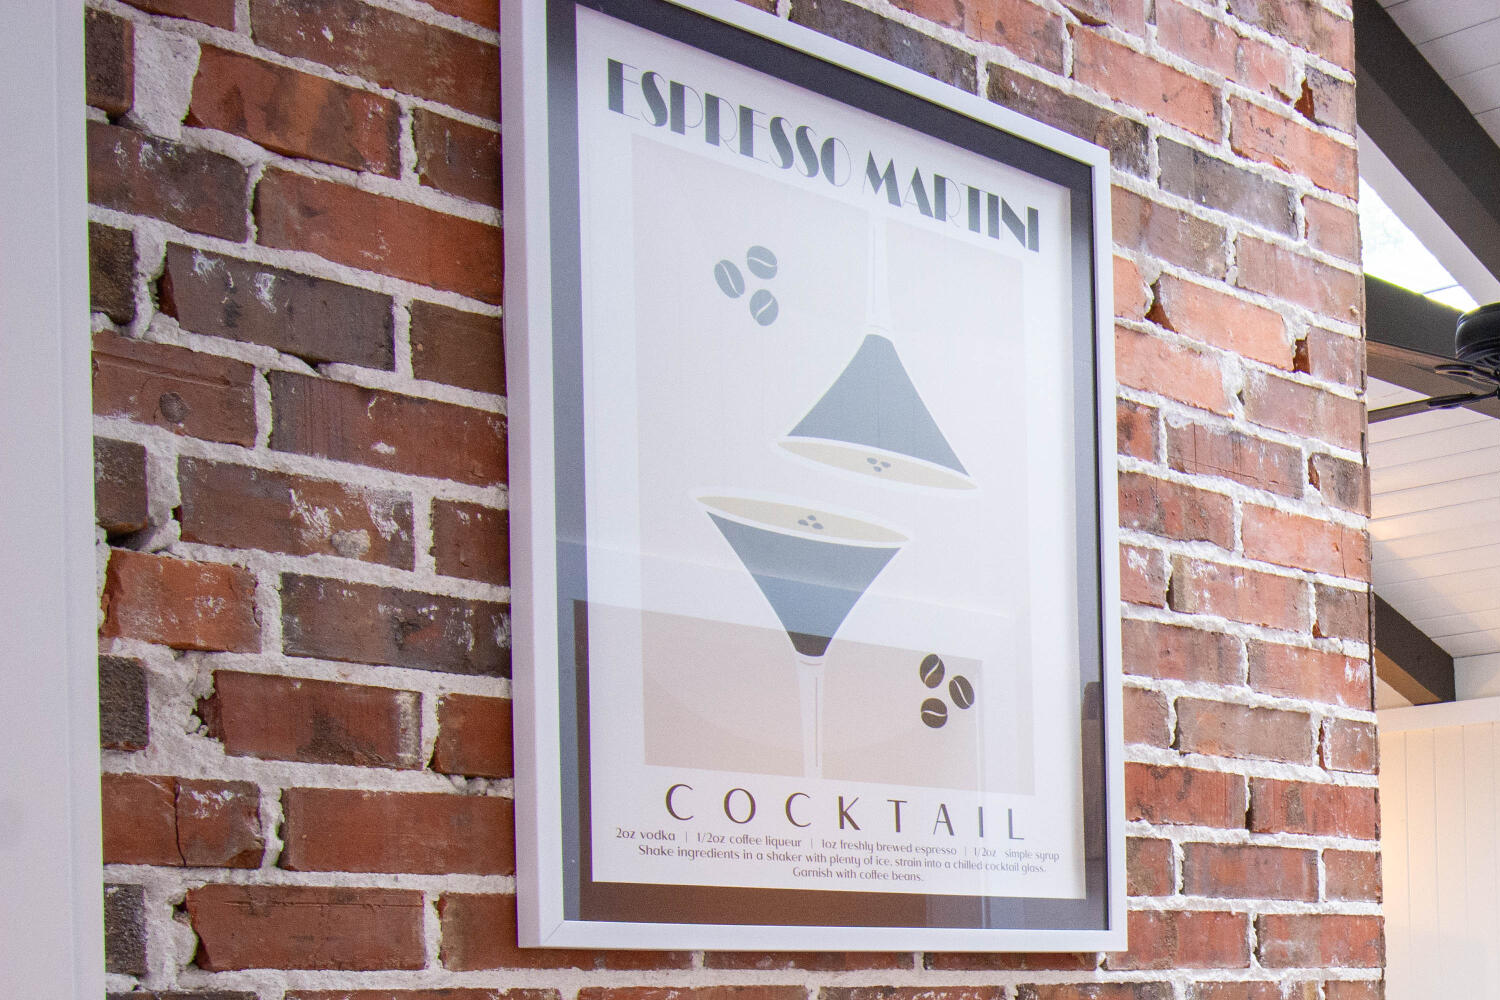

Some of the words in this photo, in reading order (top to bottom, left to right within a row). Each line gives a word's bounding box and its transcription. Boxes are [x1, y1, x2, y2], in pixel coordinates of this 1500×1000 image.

[607, 58, 851, 187] ESPRESSO
[863, 150, 1040, 253] MARTINI
[665, 783, 1026, 841] COCKTAIL
[616, 828, 635, 840] 2oz
[640, 830, 676, 842] vodka
[697, 832, 725, 844] 1/2oz
[730, 834, 762, 846] coffee
[765, 836, 802, 850] liqueur
[840, 839, 874, 854] freshly
[876, 841, 912, 853] brewed
[915, 845, 957, 857] espresso
[1004, 848, 1033, 860] simple
[1036, 852, 1060, 864] syrup
[638, 844, 674, 857] Shake
[678, 846, 740, 862] ingredients
[743, 850, 752, 860] in
[756, 852, 764, 861] a
[766, 850, 802, 862] shaker
[805, 852, 827, 864] with
[830, 854, 861, 868] plenty
[864, 855, 874, 866] of
[895, 857, 922, 868] strain
[924, 858, 942, 868] into
[944, 861, 951, 869] a
[953, 858, 982, 870] chilled
[985, 860, 1020, 872] cocktail
[792, 866, 832, 879] Garnish
[836, 868, 857, 879] with
[860, 869, 889, 880] coffee
[892, 870, 924, 882] beans.
